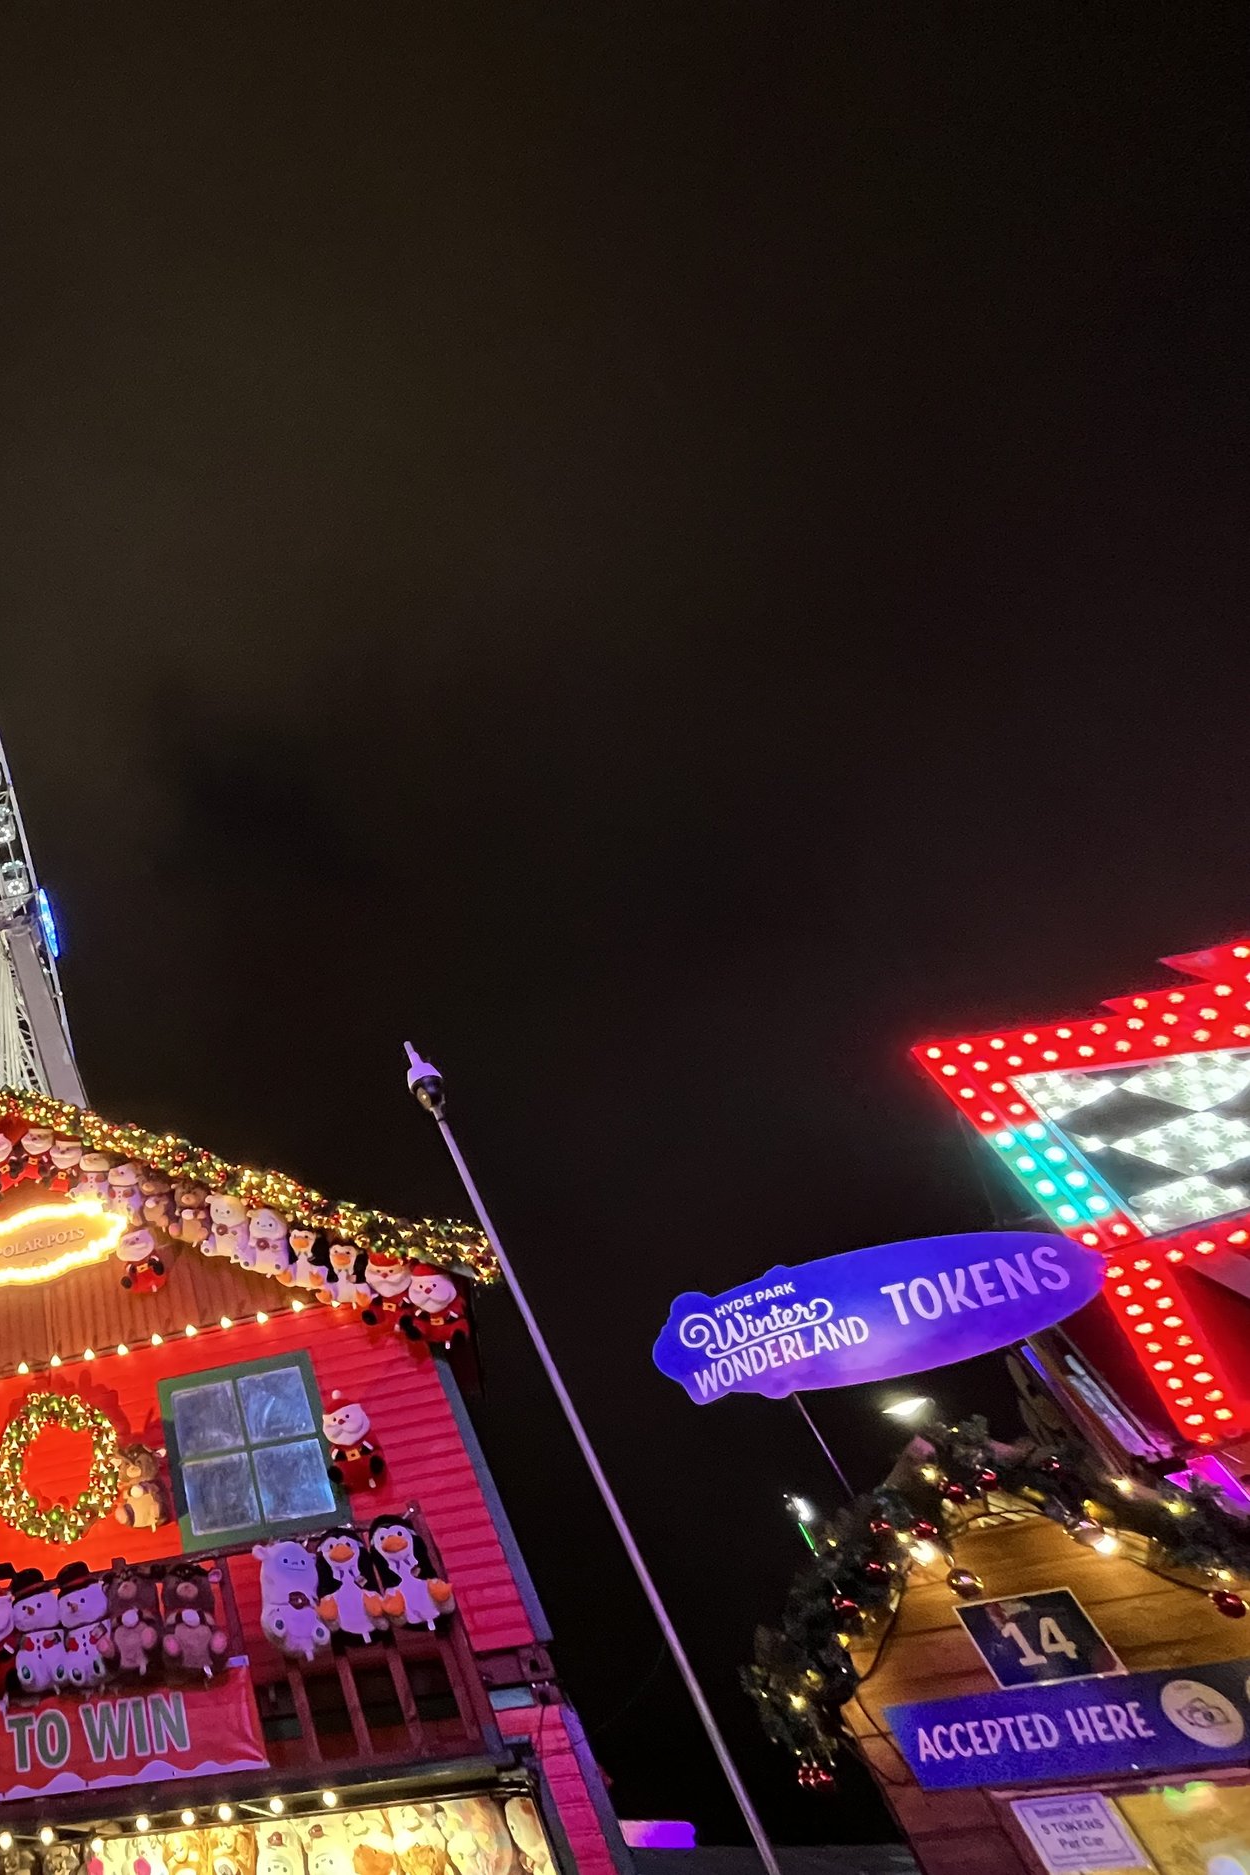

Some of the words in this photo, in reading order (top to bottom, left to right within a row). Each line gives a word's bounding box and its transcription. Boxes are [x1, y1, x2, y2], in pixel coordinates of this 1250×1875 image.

[46, 1227, 86, 1249] POTS
[714, 1293, 754, 1318] HYDE
[755, 1281, 796, 1303] PARK
[880, 1245, 1071, 1326] TOKENS
[679, 1298, 833, 1359] Winter
[693, 1316, 870, 1398] WONDERLAND
[1001, 1616, 1079, 1667] 14
[4, 1709, 71, 1773] TO
[78, 1692, 191, 1762] WIN
[917, 1713, 1059, 1763] ACCEPTED
[1065, 1701, 1156, 1745] HERE
[1052, 1818, 1104, 1833] TOKENS
